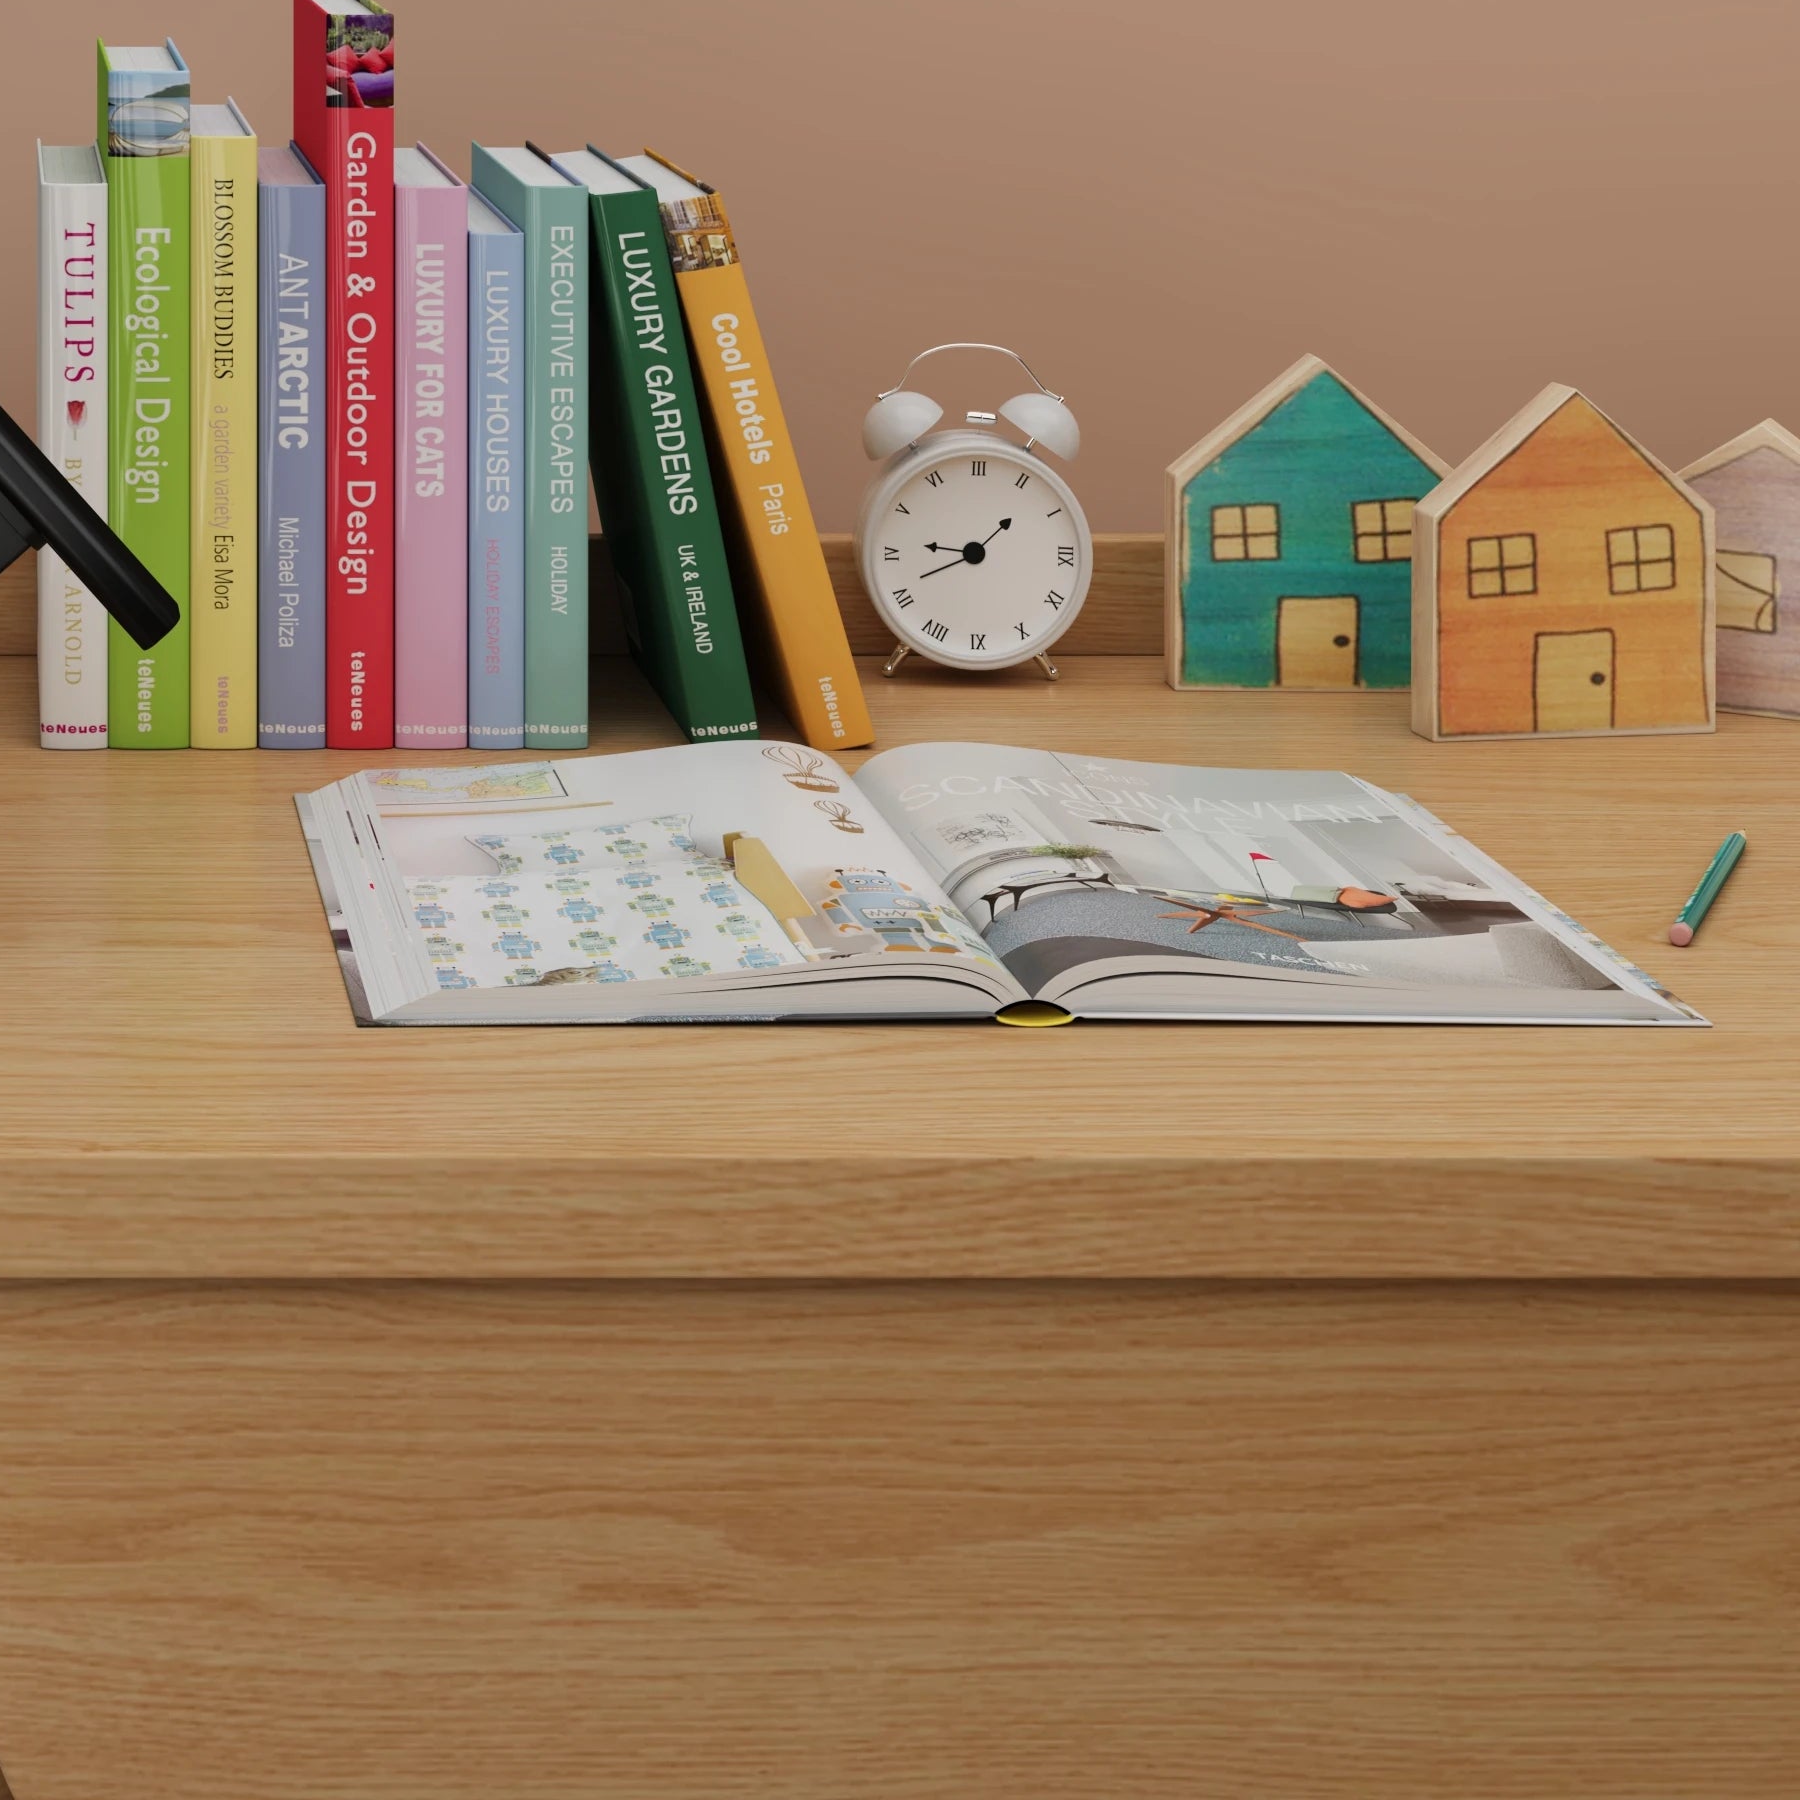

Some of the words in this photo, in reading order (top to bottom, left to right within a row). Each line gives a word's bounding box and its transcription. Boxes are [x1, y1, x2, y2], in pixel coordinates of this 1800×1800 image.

[214, 178, 234, 277] BLOSSOM
[346, 131, 377, 258] Garden
[64, 222, 95, 382] TULIPS
[125, 227, 171, 382] Ecological
[346, 274, 376, 298] &
[416, 243, 444, 354] LUXURY
[550, 226, 574, 378] EXECUTIVE
[214, 285, 234, 379] BUDDIES
[278, 253, 309, 450] ANTARCTIC
[486, 269, 509, 384] LUXURY
[711, 312, 751, 373] Cool
[346, 312, 377, 466] Outdoor
[416, 365, 444, 418] FOR
[618, 230, 667, 354] LUXURY
[644, 364, 699, 515] GARDENS
[213, 405, 228, 414] a
[730, 378, 772, 465] Hotels
[65, 458, 82, 486] BY
[125, 398, 171, 504] Design
[209, 419, 234, 473] garden
[416, 428, 444, 499] CATS
[486, 394, 510, 513] HOUSES
[550, 387, 574, 514] ESCAPES
[208, 478, 233, 530] variety
[338, 481, 377, 595] Design
[759, 483, 790, 536] Paris
[214, 535, 234, 563] Eisa
[278, 517, 300, 587] Michael
[486, 538, 501, 601] HOLIDAY
[551, 546, 567, 615] HOLIDAY
[677, 544, 697, 567] UK
[682, 570, 699, 583] &
[214, 570, 234, 610] Mora
[278, 593, 300, 647] Poliza
[685, 586, 713, 655] IRELAND
[65, 585, 83, 685] ARNOLD
[486, 606, 501, 675] ESCAPES
[137, 658, 153, 733] teNeues
[217, 676, 230, 734] teNeues
[350, 650, 366, 732] teNeues
[818, 676, 847, 739] teNeues
[41, 722, 108, 735] teNeues
[259, 722, 326, 735] teNeues
[689, 719, 758, 738] teNeues
[898, 775, 1384, 824] SCANDINAVIAN
[1060, 799, 1265, 839] STYLE
[1250, 951, 1371, 973] TASCHEN
